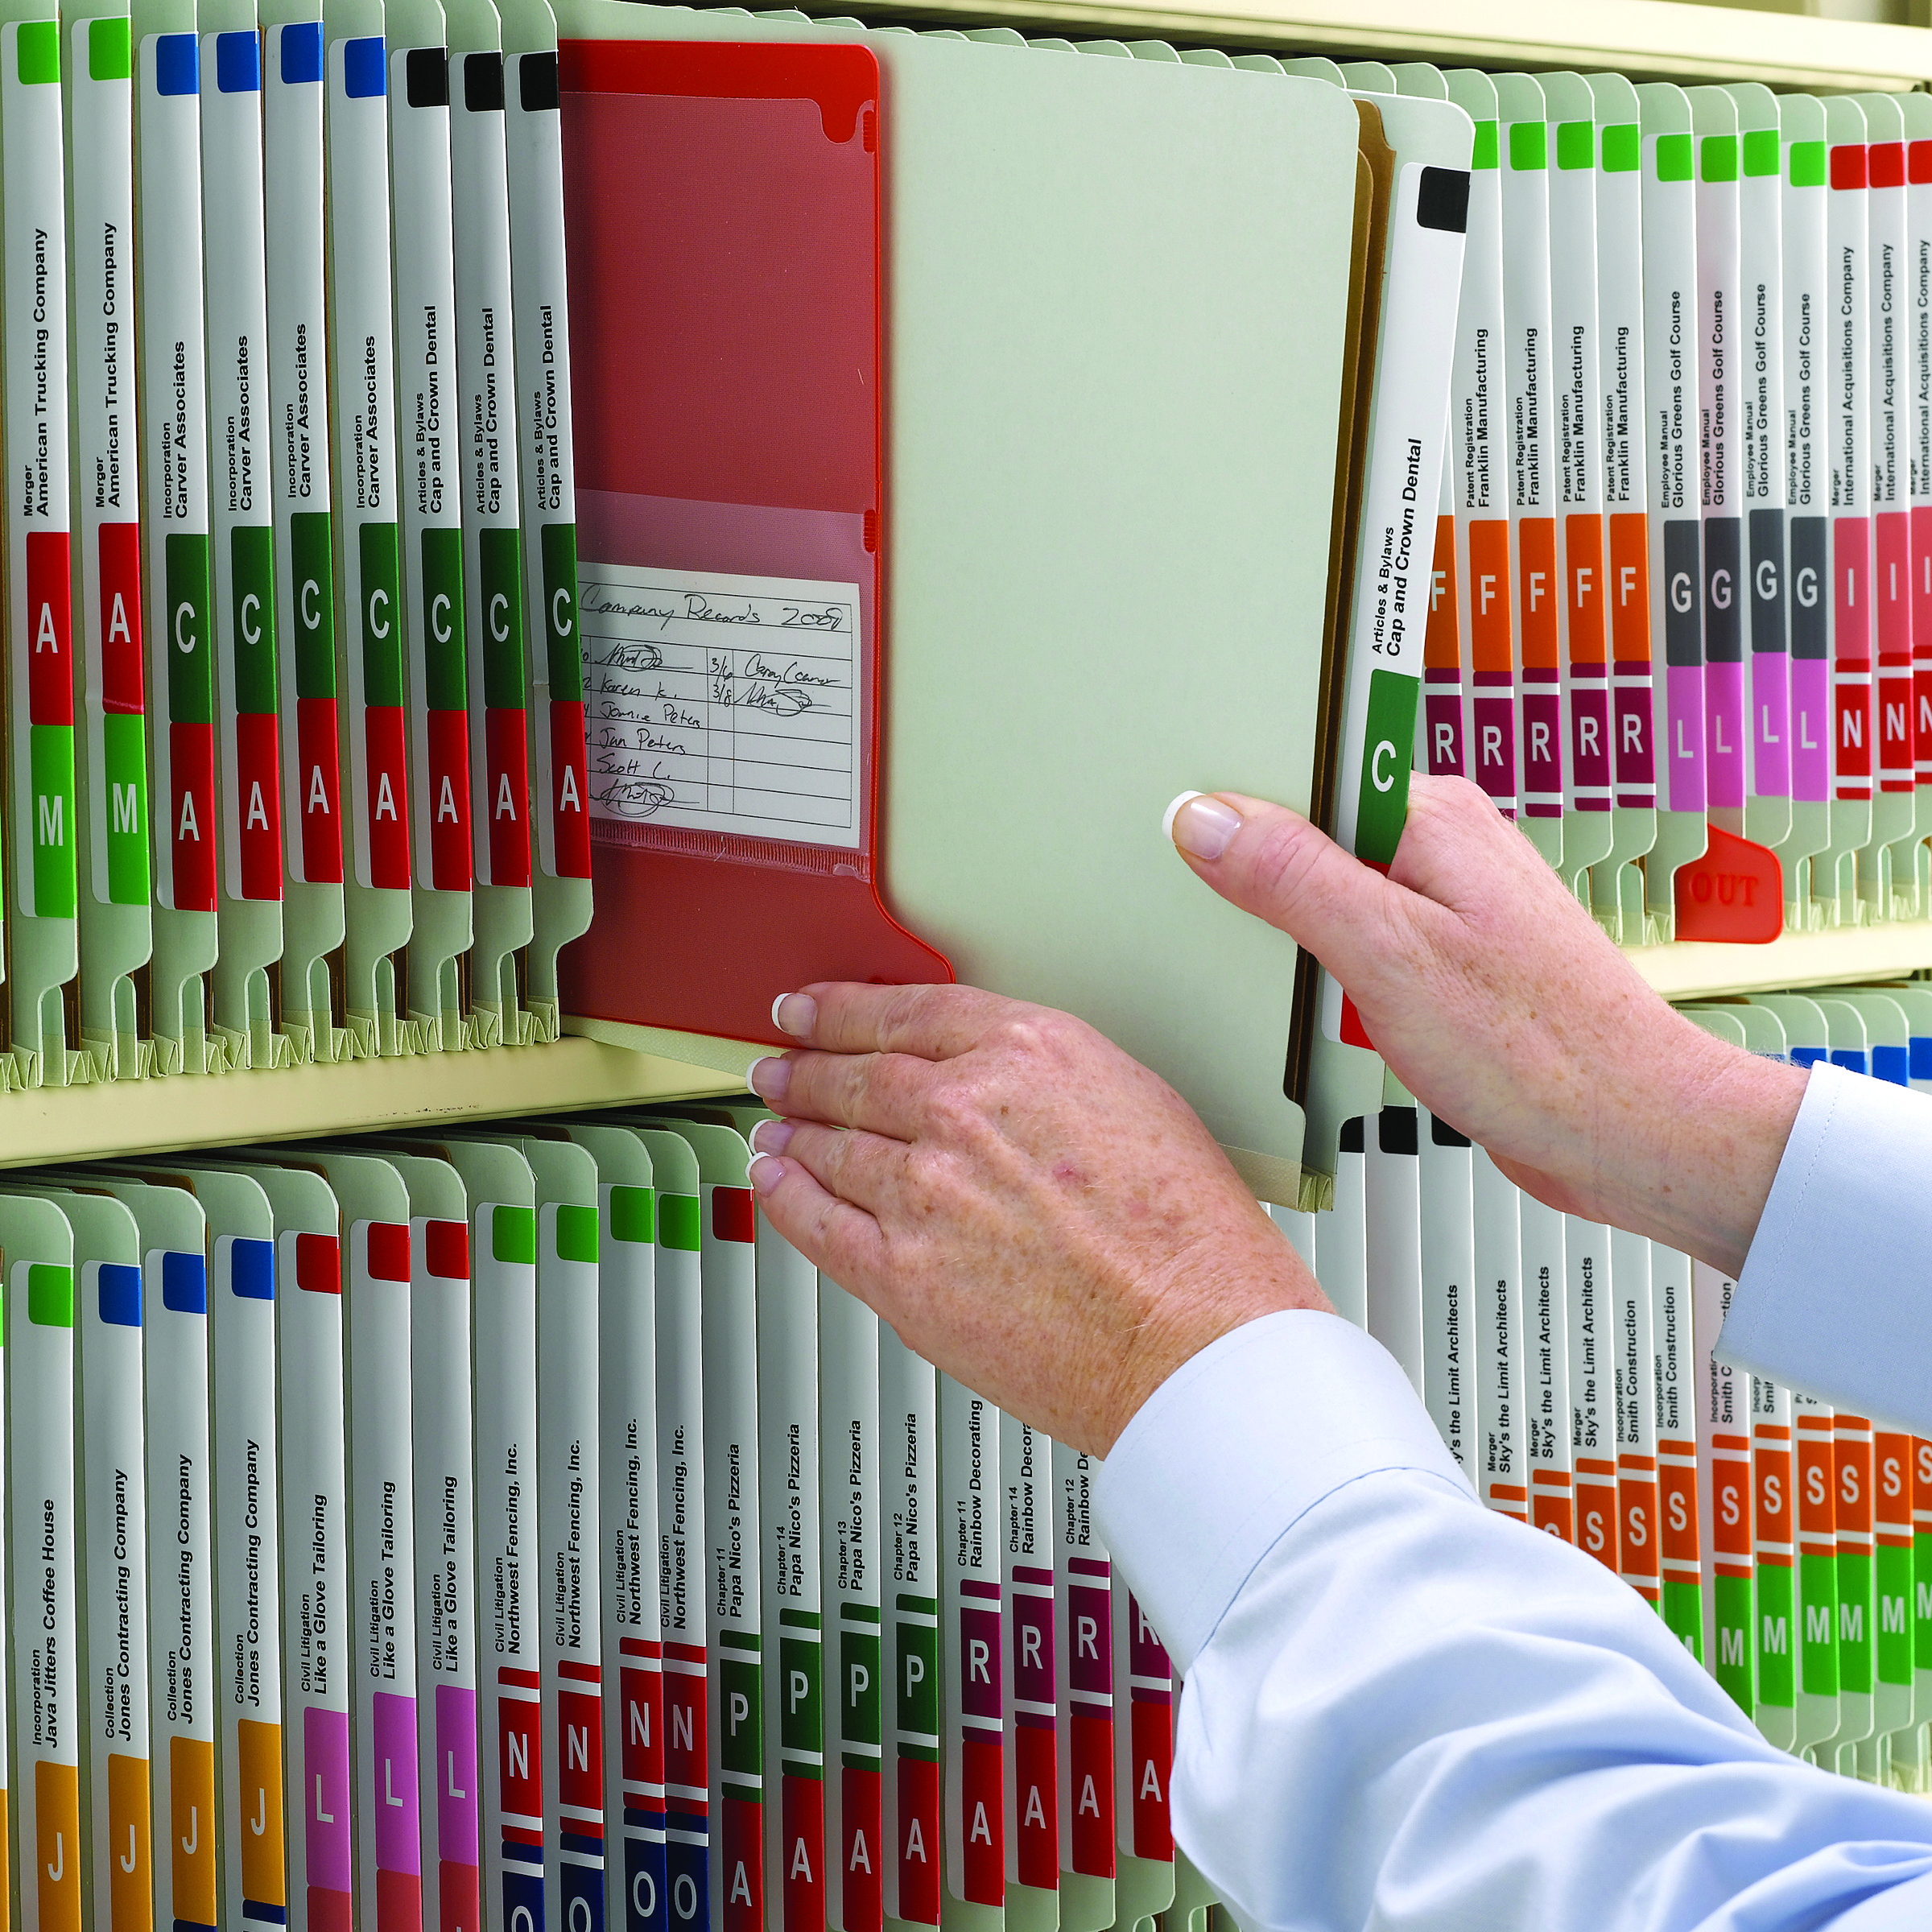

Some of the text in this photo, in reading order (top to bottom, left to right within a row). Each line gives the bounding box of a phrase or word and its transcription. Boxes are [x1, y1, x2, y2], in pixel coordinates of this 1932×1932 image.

[33, 228, 49, 518] American Trucking Company
[102, 222, 121, 508] American Trucking Company
[423, 305, 444, 514] Cap and Crown Dental
[1670, 291, 1684, 509] Glorious Greens Golf Course
[1754, 283, 1769, 497] Glorious Greens Golf Course
[1840, 246, 1856, 506] International Acquisitions Company
[1880, 244, 1896, 501] International Acquisitions Company
[172, 341, 188, 518] Carver Associates
[364, 336, 380, 509] Carver Associates
[415, 392, 427, 514] Articles & Bylaws
[1474, 328, 1490, 508] Franklin Manufacturing
[1615, 327, 1630, 502] Franklin Manufacturing
[23, 464, 35, 517] Merger
[95, 456, 106, 508] Merger
[161, 422, 174, 518] Incorporation
[353, 415, 366, 509] Incorporation
[1372, 526, 1394, 654] Articles & Bylaws
[1386, 438, 1422, 657] Cap and Crown Dental
[1756, 559, 1777, 601] G
[35, 602, 59, 654] A
[552, 588, 572, 637] C
[581, 584, 675, 630] Company
[684, 594, 761, 622] Records
[1480, 575, 1496, 615] F
[1371, 740, 1397, 793] C
[1483, 725, 1505, 766] R
[1762, 704, 1780, 743] L
[39, 795, 64, 847] M
[559, 765, 581, 812] A
[1690, 871, 1758, 907] OUT
[1496, 1279, 1513, 1474] Sky's the Limit Architects
[1581, 1257, 1600, 1447] Sky's the Limit Architects
[1624, 1300, 1639, 1443] Smith Construction
[1653, 1354, 1666, 1428] Incorporation
[1663, 1286, 1679, 1429] Smith Construction
[1487, 1431, 1498, 1472] Merger
[1573, 1407, 1583, 1447] Merger
[1614, 1368, 1626, 1443] Incorporation
[625, 1418, 642, 1625] Northwest Fencing, Inc.
[786, 1423, 805, 1597] Papa Nico's Pizzeria
[904, 1413, 921, 1583] Papa Nico's Pizzeria
[968, 1399, 984, 1568] Rainbow Decorating
[1008, 1486, 1021, 1553] Chapter 14
[1021, 1422, 1034, 1554] Rainbow Decor
[1721, 1485, 1740, 1525] S
[245, 1439, 262, 1707] Jones Contracting Company
[380, 1480, 396, 1680] Like a Glove Tailoring
[505, 1443, 521, 1655] Northwest Fencing, Inc.
[614, 1530, 627, 1624] Civil Litigation
[776, 1525, 788, 1596] Chapter 14
[893, 1513, 905, 1581] Chapter 12
[956, 1501, 969, 1567] Chapter 11
[41, 1499, 58, 1749] Java Jitters Coffee House
[114, 1468, 131, 1742] Jones Contracting Company
[369, 1579, 382, 1678] Civil Litigation
[493, 1557, 506, 1653] Civil Litigation
[1721, 1626, 1744, 1667] M
[31, 1649, 43, 1746] Incorporation
[104, 1667, 115, 1739] Collection
[234, 1633, 245, 1704] Collection
[851, 1663, 869, 1707] P
[969, 1639, 991, 1684] R
[508, 1731, 529, 1780] N
[120, 1824, 136, 1873] J
[633, 1871, 656, 1918] O
[849, 1829, 872, 1875] A
